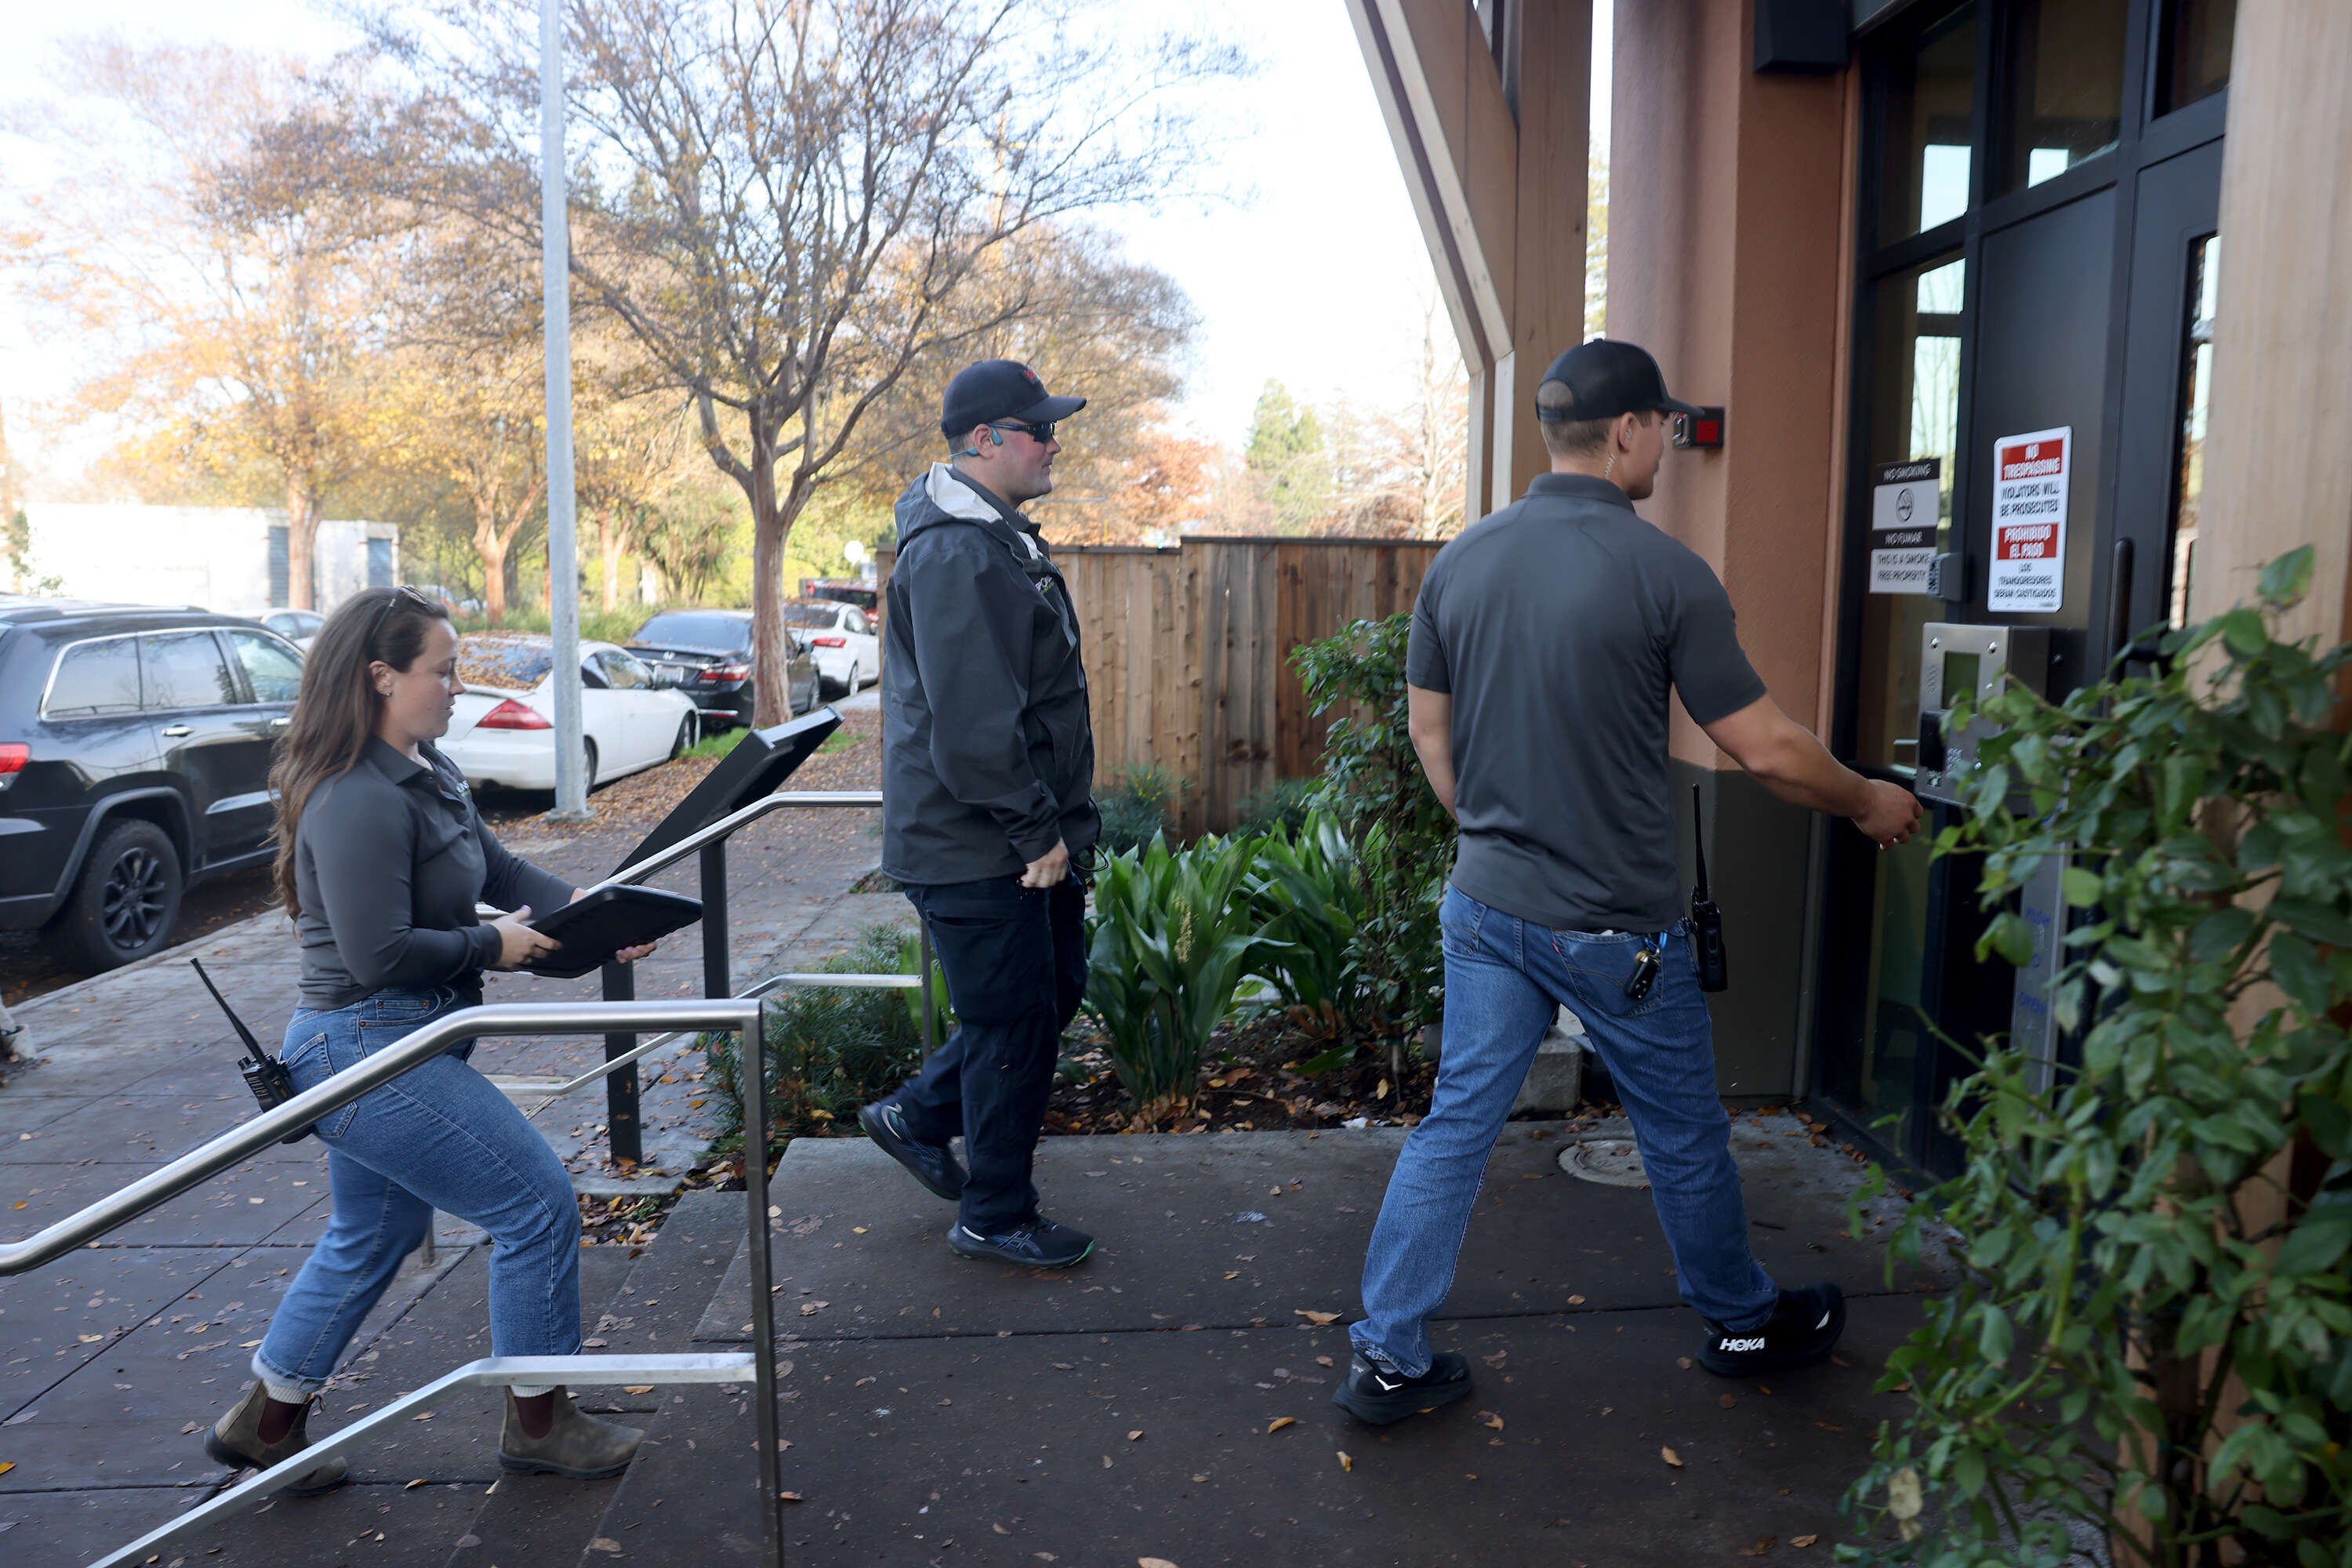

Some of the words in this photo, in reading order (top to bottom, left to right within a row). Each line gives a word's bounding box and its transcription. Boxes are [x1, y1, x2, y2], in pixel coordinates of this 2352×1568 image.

[2025, 443, 2039, 461] NO
[1883, 468, 1896, 482] NO
[1896, 463, 1931, 479] SMOKING
[2003, 456, 2060, 480] TRESPASSING
[2002, 483, 2039, 500] VIOLATORS
[2043, 480, 2060, 495] WILL
[2000, 503, 2010, 517] BE
[2012, 499, 2059, 516] PROSECUTED
[1885, 533, 1897, 546] NO
[1897, 532, 1923, 545] FUMAR
[2004, 524, 2052, 543] PROHIBIDO
[2009, 543, 2020, 559] EL
[2021, 542, 2045, 558] PASO
[1719, 1338, 1765, 1352] HOKA
